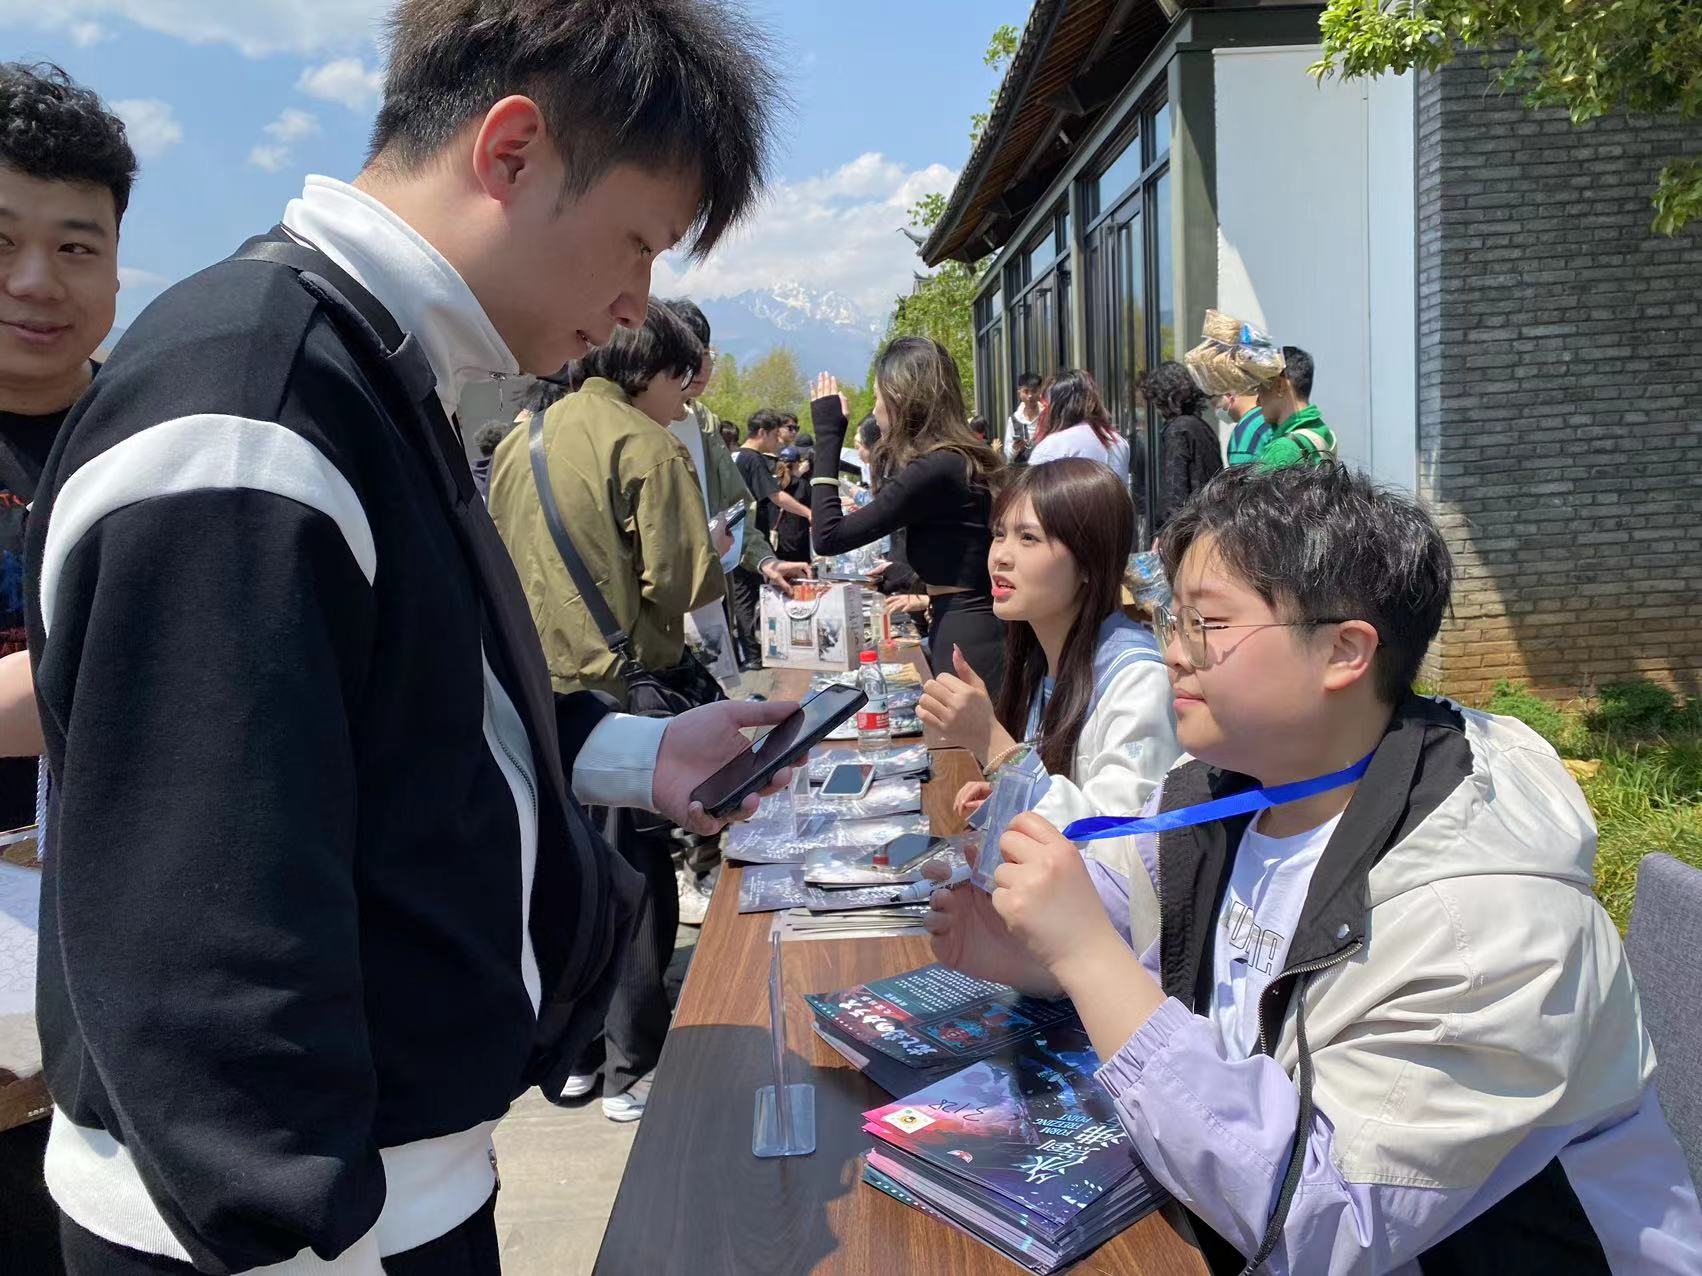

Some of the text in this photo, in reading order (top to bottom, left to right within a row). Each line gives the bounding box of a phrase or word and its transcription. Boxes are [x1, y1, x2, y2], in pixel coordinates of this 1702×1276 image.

[1033, 1118, 1084, 1130] FREEZING
[1057, 1113, 1093, 1124] POINT
[1039, 1127, 1075, 1137] FORM
